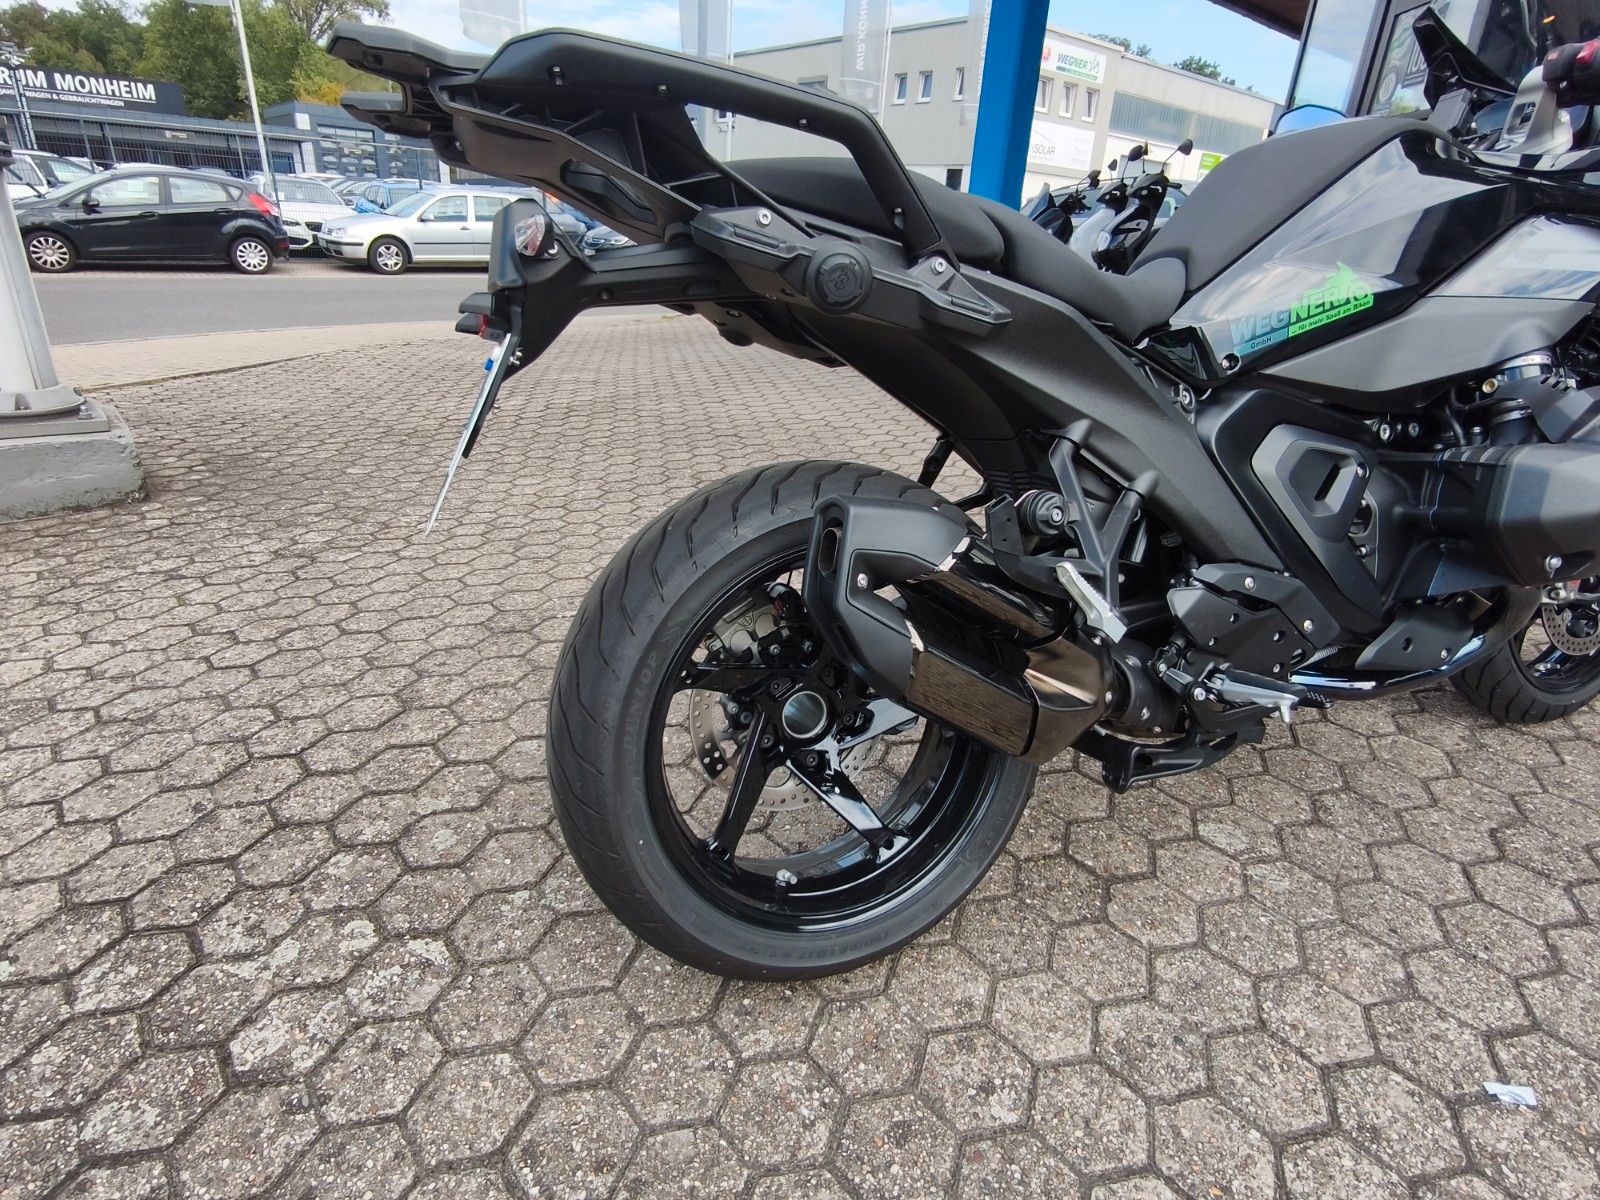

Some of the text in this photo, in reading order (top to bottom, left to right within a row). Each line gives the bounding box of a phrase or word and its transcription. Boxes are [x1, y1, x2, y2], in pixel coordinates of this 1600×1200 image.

[1057, 52, 1088, 70] WEGNER
[53, 72, 156, 100] MONHEIM
[59, 94, 124, 107] GEBRAUCHTWAGEN
[1250, 335, 1272, 349] GmbH
